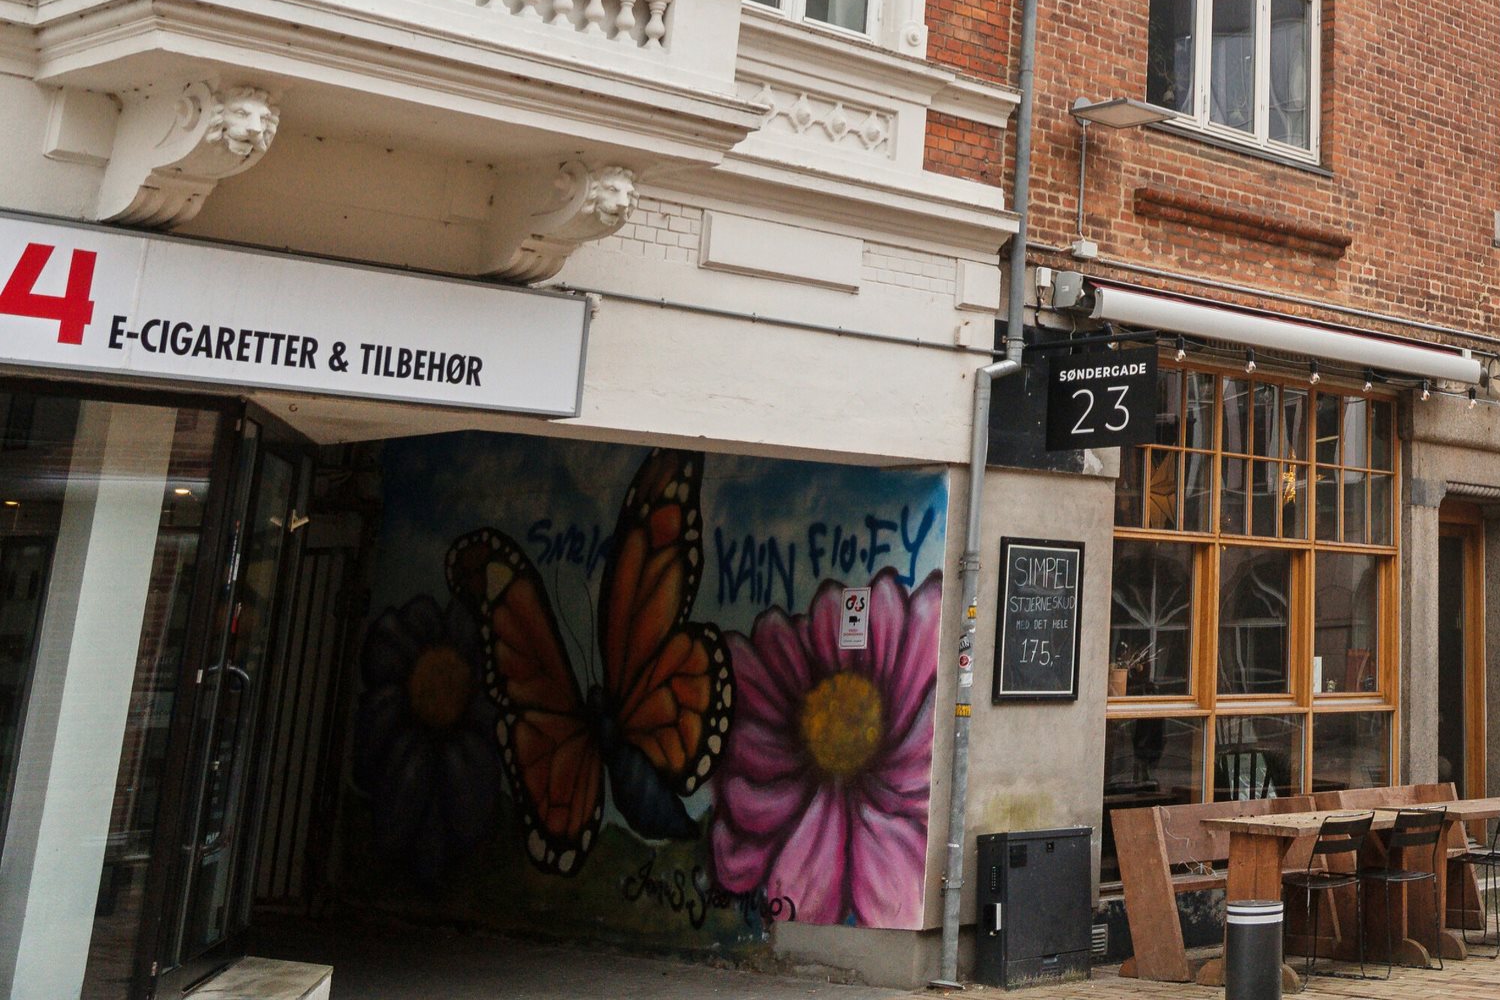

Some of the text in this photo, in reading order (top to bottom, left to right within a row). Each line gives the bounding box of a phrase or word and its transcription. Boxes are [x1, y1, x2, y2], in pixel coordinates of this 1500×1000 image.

[0, 242, 97, 345] 4
[108, 314, 484, 387] E-CIGARETTER & TILBEHØR
[1059, 362, 1147, 382] SØNDERGADE
[1071, 385, 1129, 434] 23
[1014, 556, 1075, 590] SIMPEL
[1010, 595, 1076, 613] STJERNESKUD
[1016, 619, 1068, 630] MED DET HELE
[1019, 638, 1061, 667] 175,-
